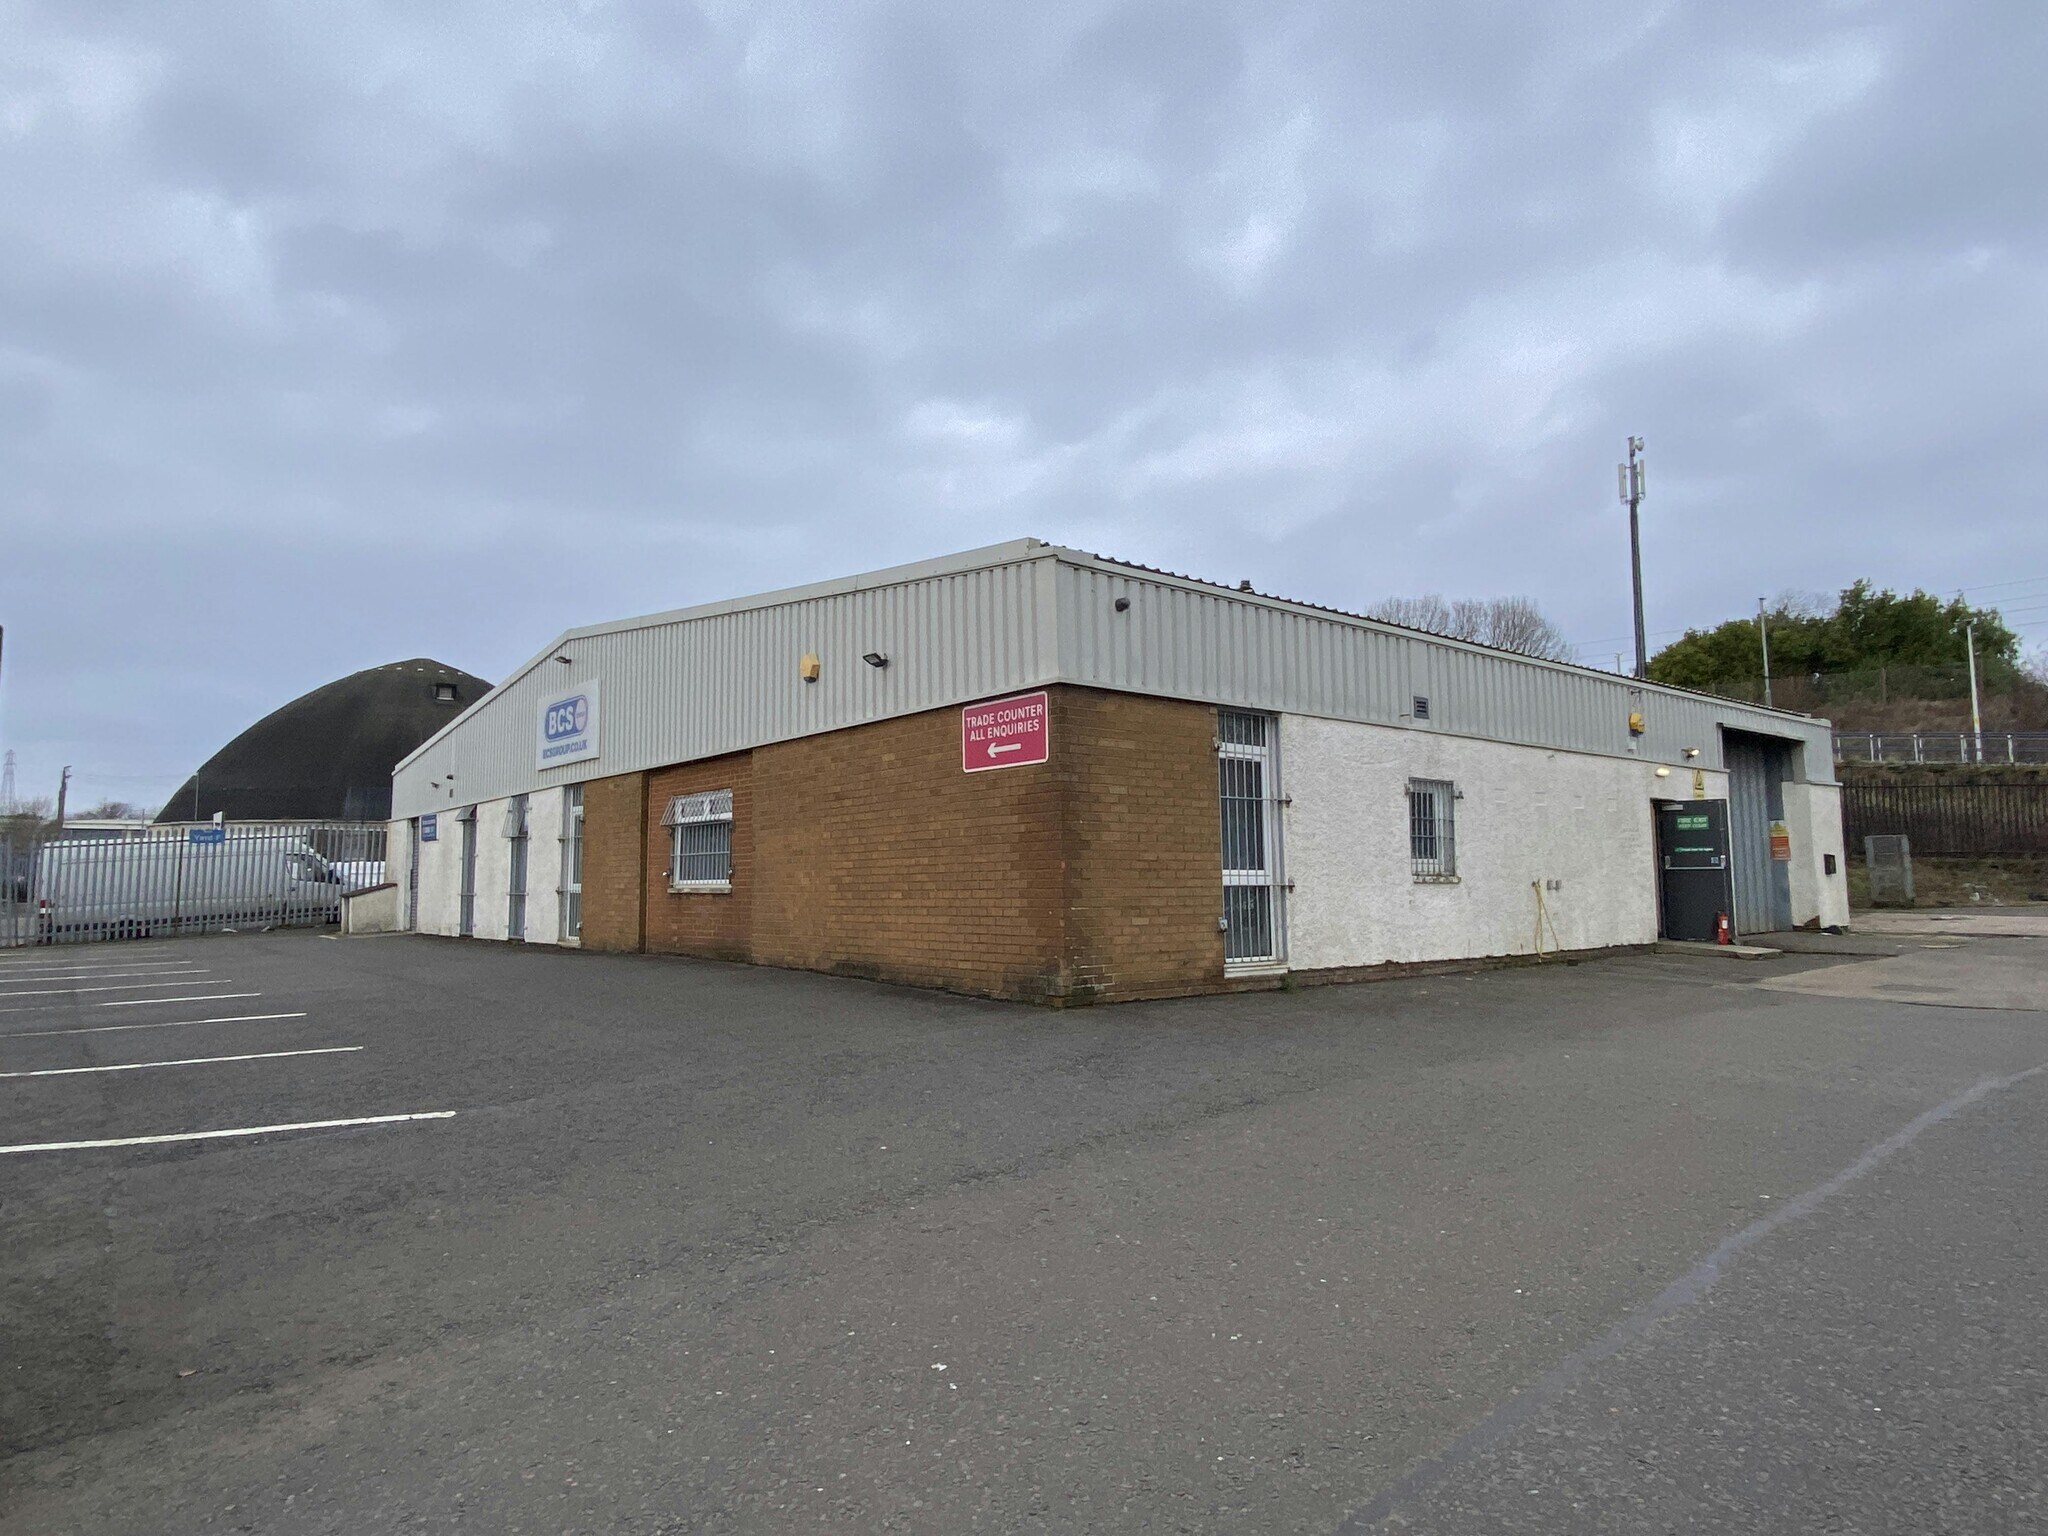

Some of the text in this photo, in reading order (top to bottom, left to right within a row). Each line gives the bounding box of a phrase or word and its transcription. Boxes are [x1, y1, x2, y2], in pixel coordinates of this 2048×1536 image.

[548, 706, 574, 735] BCS
[966, 704, 1043, 728] TRADE COUNTER
[970, 719, 1039, 741] ALL ENQUIRIES
